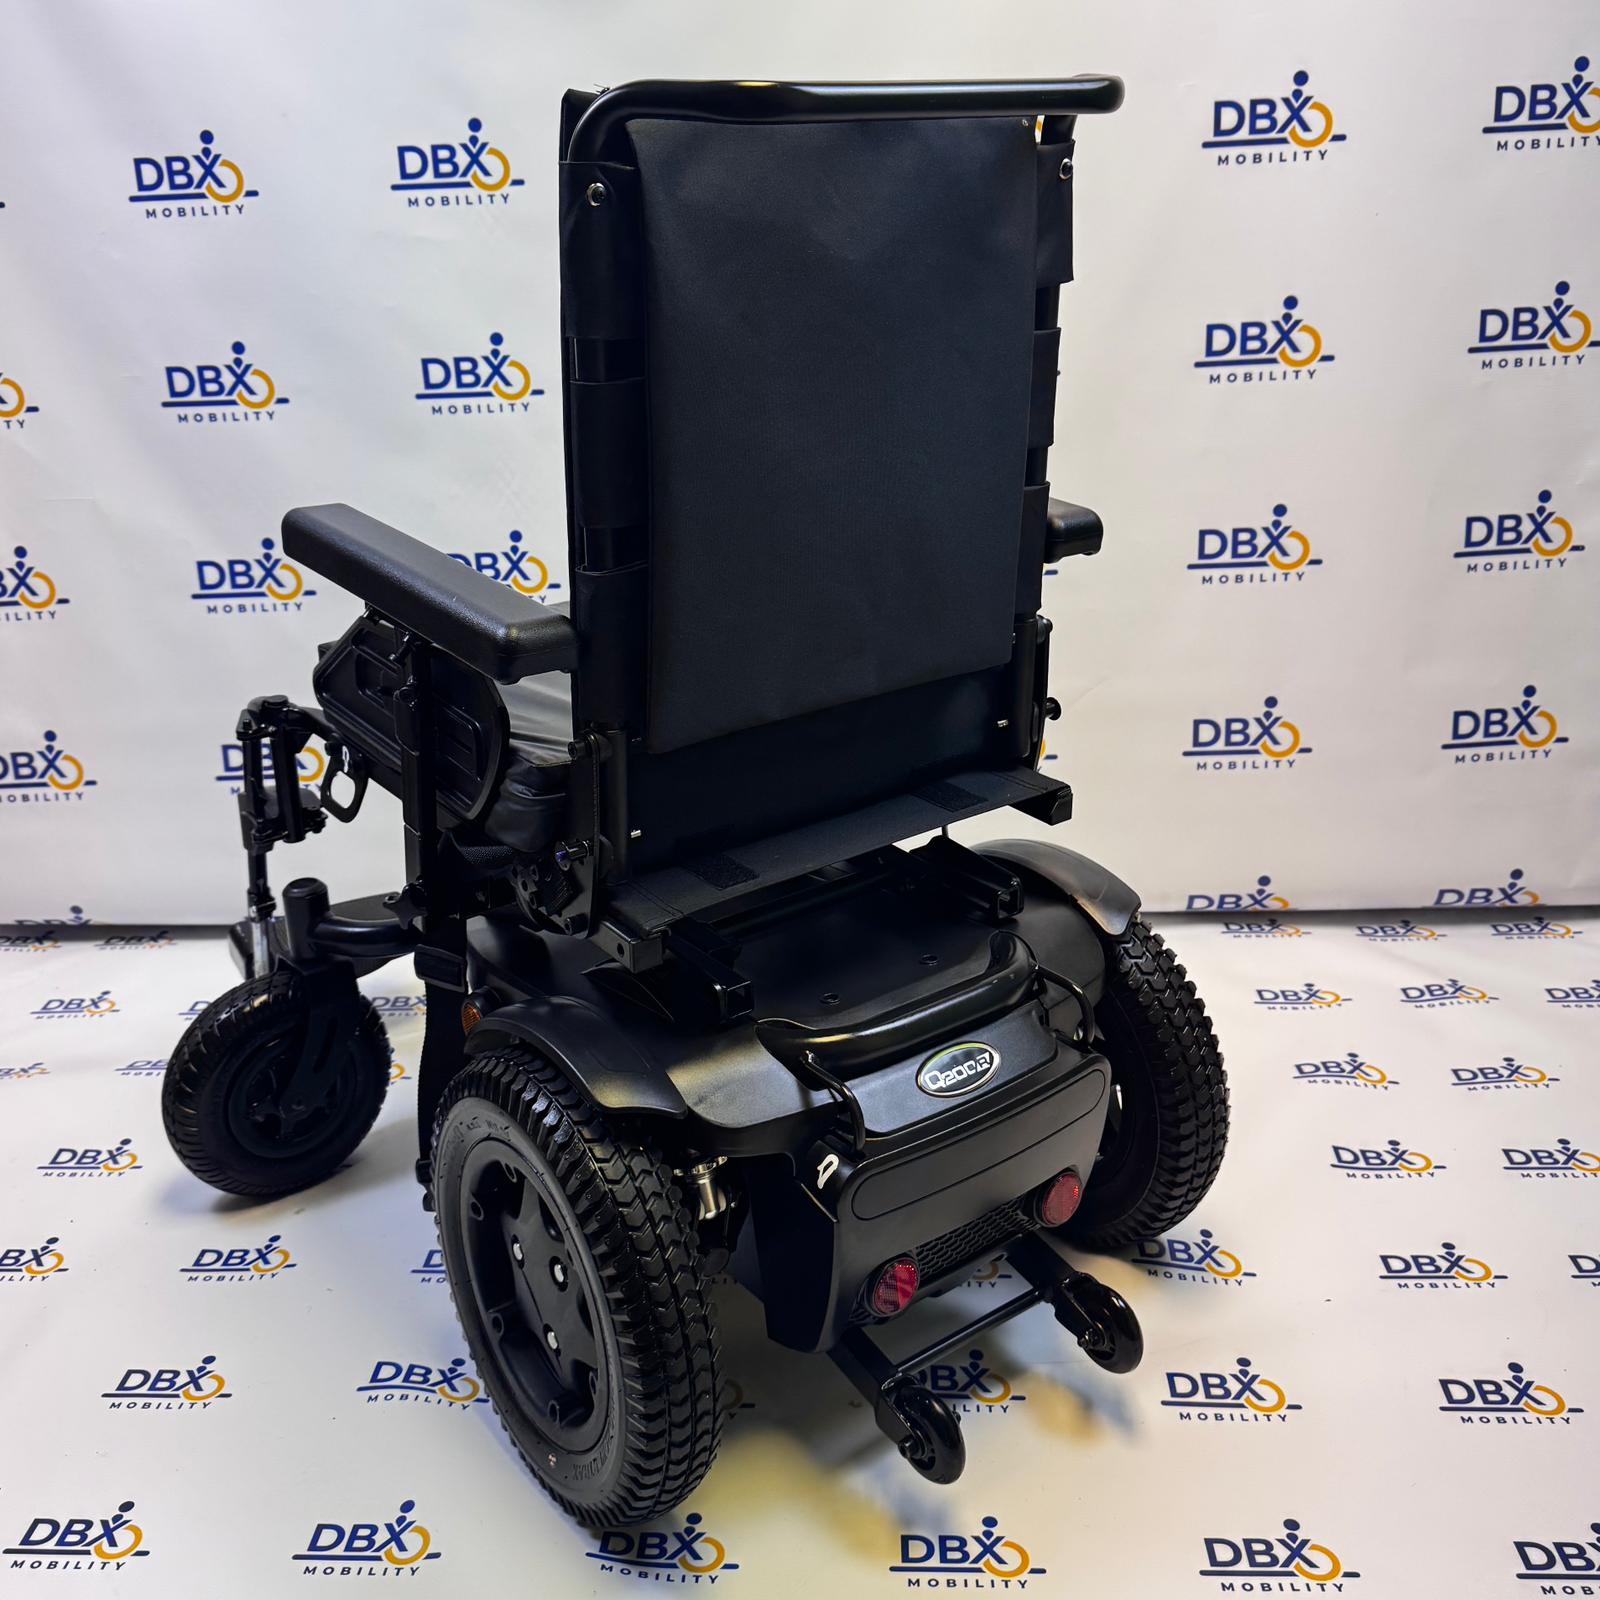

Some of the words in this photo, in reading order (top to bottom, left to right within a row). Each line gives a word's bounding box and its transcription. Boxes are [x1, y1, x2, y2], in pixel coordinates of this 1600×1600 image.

[1493, 81, 1594, 122] DBX
[1213, 96, 1313, 137] DBX
[397, 143, 489, 180] DBX
[1217, 150, 1329, 166] MOBILITY
[133, 153, 225, 191] DBX
[408, 194, 510, 207] MOBILITY
[146, 205, 245, 218] MOBILITY
[1478, 305, 1574, 343] DBX
[1205, 320, 1303, 358] DBX
[1481, 355, 1585, 370] MOBILITY
[166, 363, 257, 398] DBX
[421, 355, 512, 390] DBX
[1209, 369, 1318, 384] MOBILITY
[178, 411, 275, 422] MOBILITY
[432, 403, 530, 415] MOBILITY
[1464, 512, 1555, 548] DBX
[1197, 525, 1292, 560] DBX
[1467, 557, 1568, 573] MOBILITY
[197, 559, 285, 590] DBX
[1202, 572, 1305, 585] MOBILITY
[207, 602, 302, 614] MOBILITY
[1452, 705, 1540, 740] DBX
[1192, 716, 1283, 748] DBX
[1197, 759, 1296, 771] MOBILITY
[1455, 749, 1553, 764] MOBILITY
[0, 792, 83, 803] OBILITY
[1186, 892, 1274, 910] DBX
[1432, 886, 1527, 906] DBX
[1255, 987, 1328, 1002] DBX
[1400, 983, 1474, 1000] DBX
[41, 998, 105, 1011] DBX
[1295, 1058, 1371, 1078] DBX
[1452, 1064, 1529, 1082] DBX
[1308, 1078, 1389, 1089] MOBILITY
[48, 1148, 129, 1165] DBX
[1332, 1145, 1415, 1166] DBX
[1501, 1148, 1591, 1165] DBX
[1347, 1171, 1436, 1179] MOBILITY
[191, 1247, 275, 1267] DBX
[1380, 1254, 1466, 1274] DBX
[187, 1273, 278, 1282] MOBILITY
[1148, 1269, 1243, 1286] MOBILITY
[115, 1368, 216, 1391] DBX
[369, 1361, 466, 1392] DBX
[1165, 1373, 1266, 1401] DBX
[1438, 1379, 1545, 1406] DBX
[109, 1401, 210, 1410] MOBILITY
[367, 1393, 470, 1410] MOBILITY
[953, 1404, 1010, 1414] ILITY
[1179, 1413, 1288, 1423] MOBILITY
[1460, 1416, 1571, 1424] MOBILITY
[19, 1518, 131, 1547] DBX
[307, 1521, 415, 1552] DBX
[599, 1530, 707, 1560] DBX
[900, 1533, 1008, 1564] DBX
[1203, 1538, 1320, 1569] DBX
[10, 1559, 125, 1571] MOBILITY
[303, 1566, 419, 1576] MOBILITY
[600, 1564, 720, 1584] MOBILITY
[908, 1578, 1028, 1589] MOBILITY
[1221, 1583, 1344, 1592] MOBILITY
